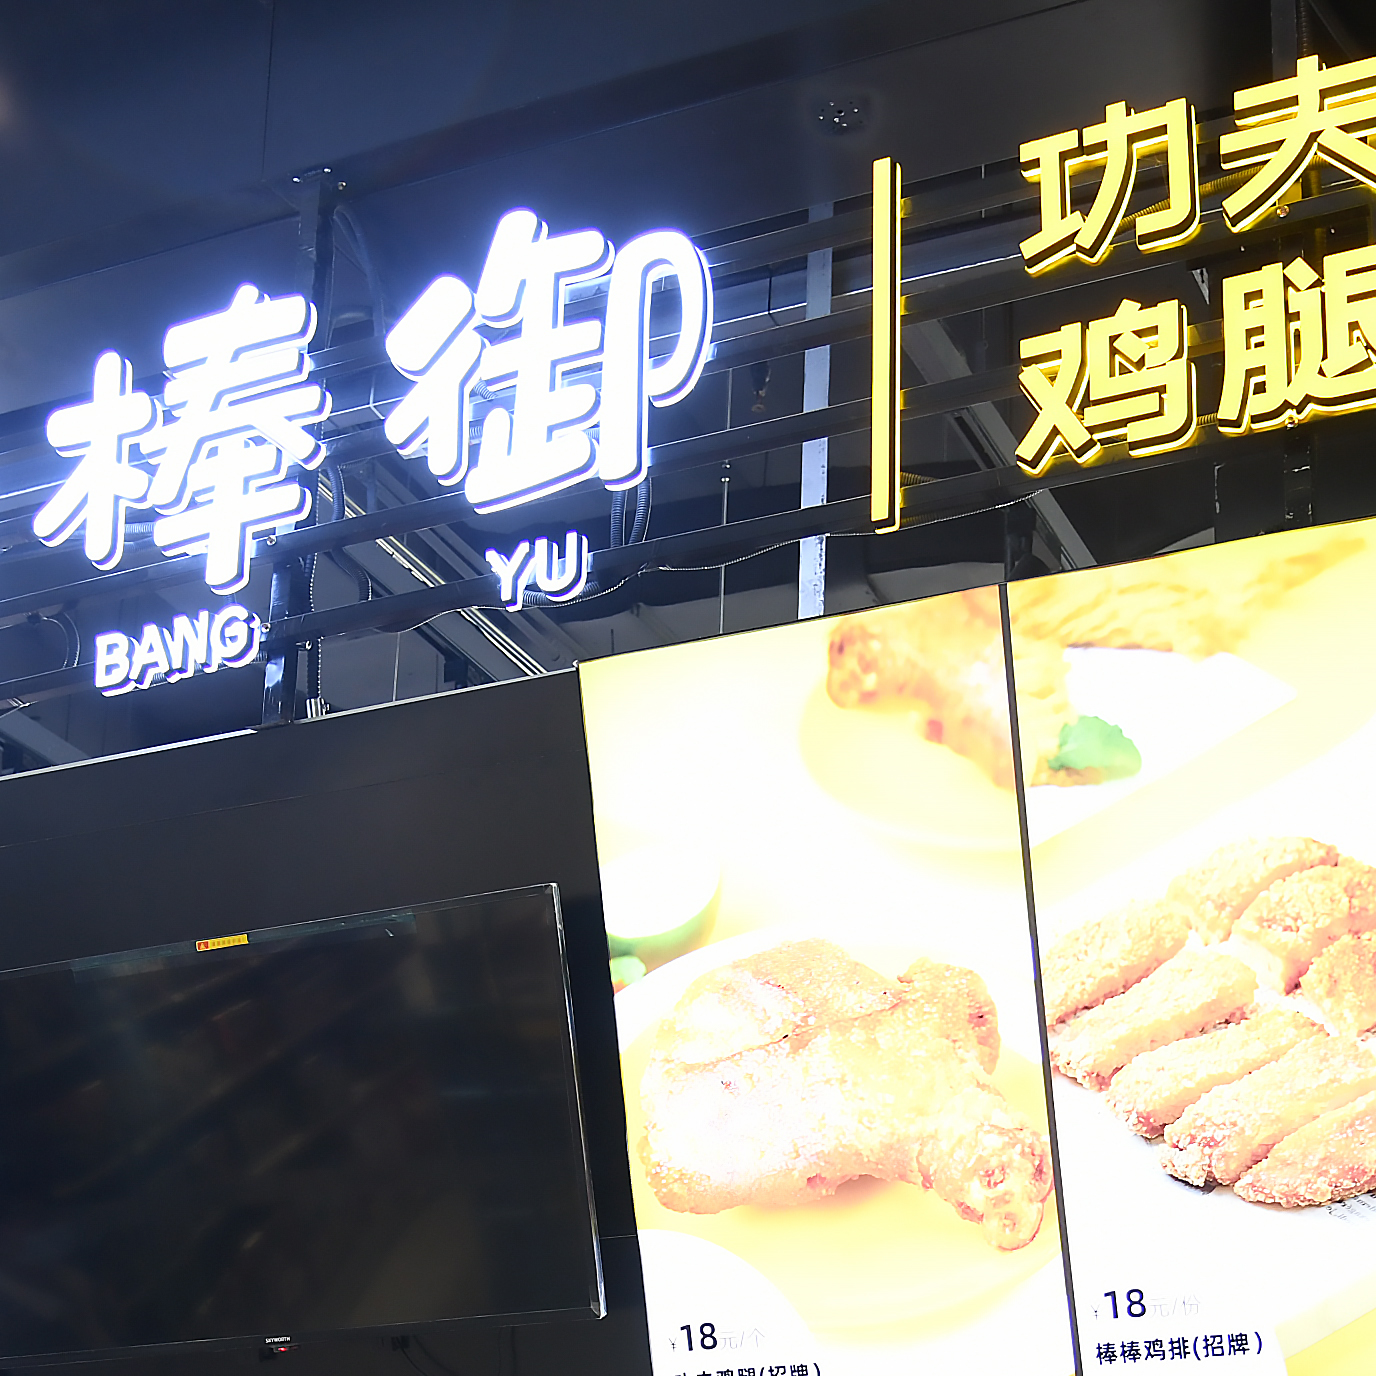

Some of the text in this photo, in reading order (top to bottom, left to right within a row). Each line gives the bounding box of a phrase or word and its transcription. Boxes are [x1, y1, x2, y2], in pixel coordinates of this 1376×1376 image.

[488, 536, 590, 612] YU
[92, 606, 264, 694] BANG
[1096, 1332, 1262, 1365] 棒棒鸡排(招牌)
